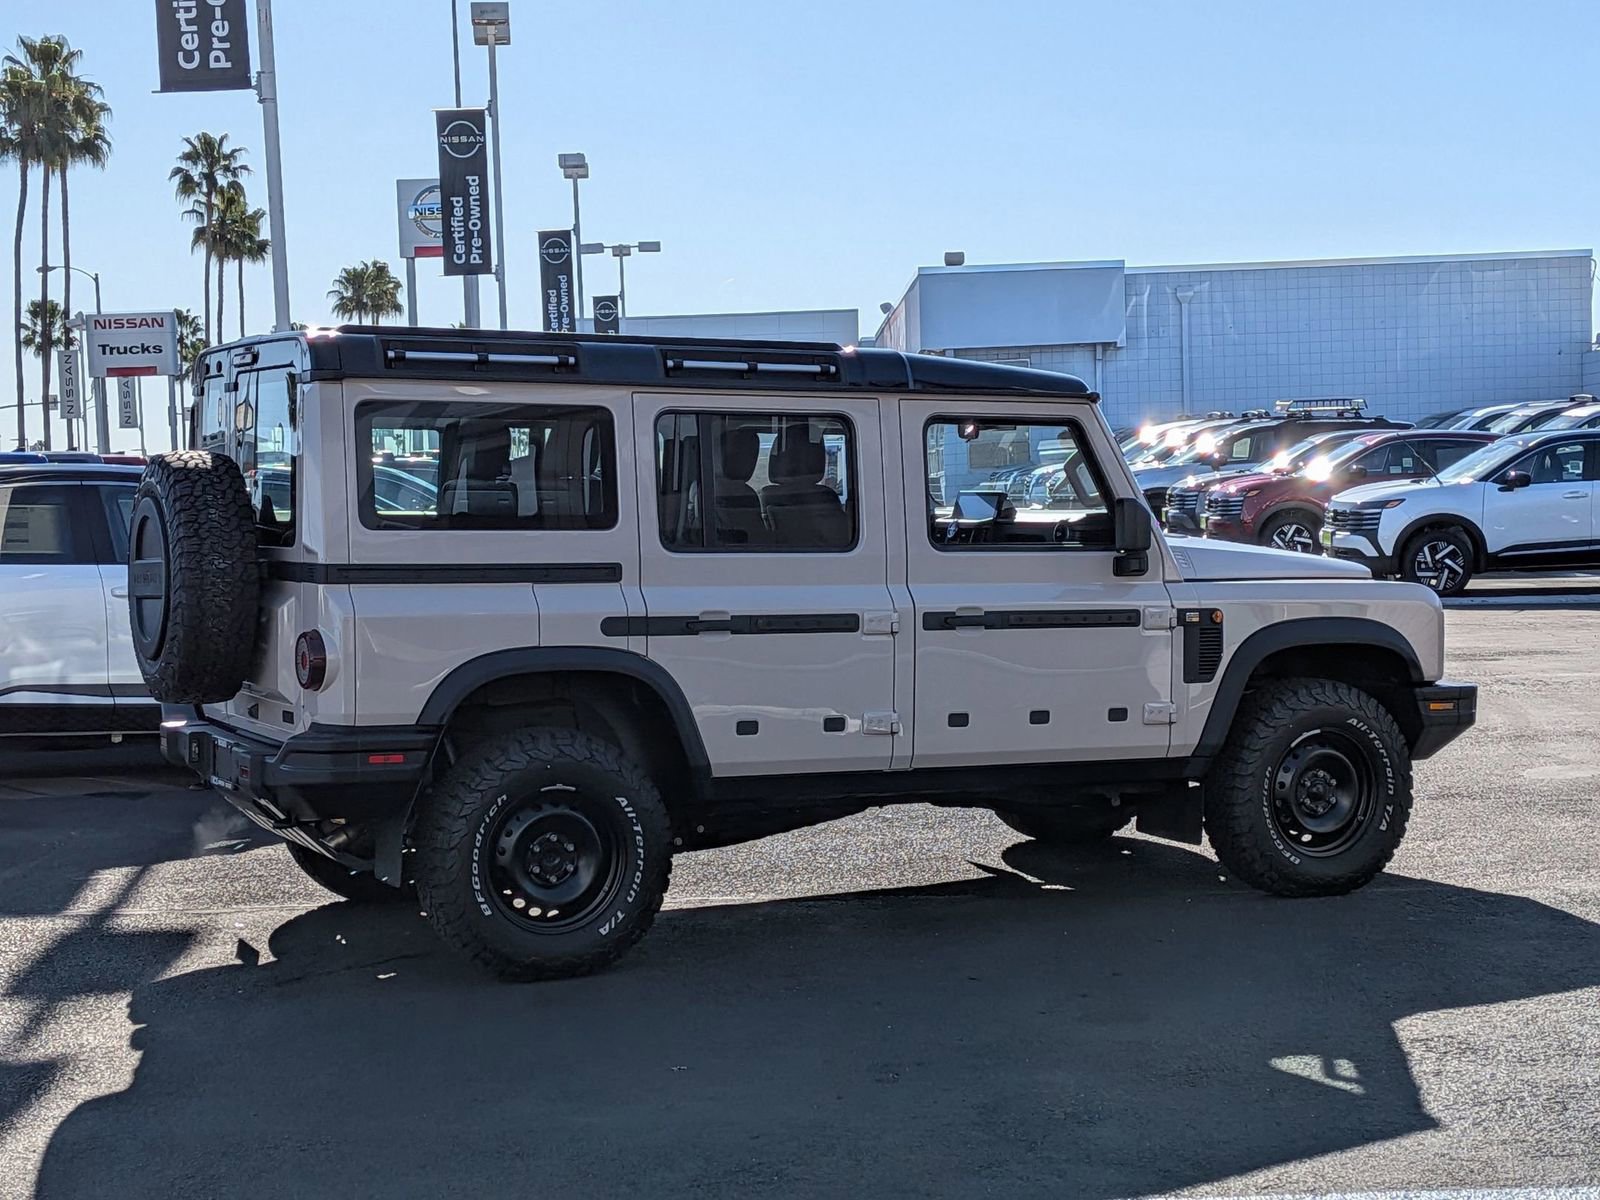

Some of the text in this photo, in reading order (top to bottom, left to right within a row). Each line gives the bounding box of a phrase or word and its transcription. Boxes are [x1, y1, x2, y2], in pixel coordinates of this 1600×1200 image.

[172, 0, 200, 69] Certi
[440, 135, 484, 143] NISSAN
[450, 196, 466, 265] Certified
[465, 175, 483, 264] Pre-Owned
[93, 317, 165, 330] NISSAN
[97, 343, 163, 355] Trucks
[64, 354, 75, 414] NISSAN
[1346, 717, 1396, 832] All-Terrain T/A
[471, 794, 508, 916] BFGoodrich
[598, 796, 645, 936] All-Terrain T/A
